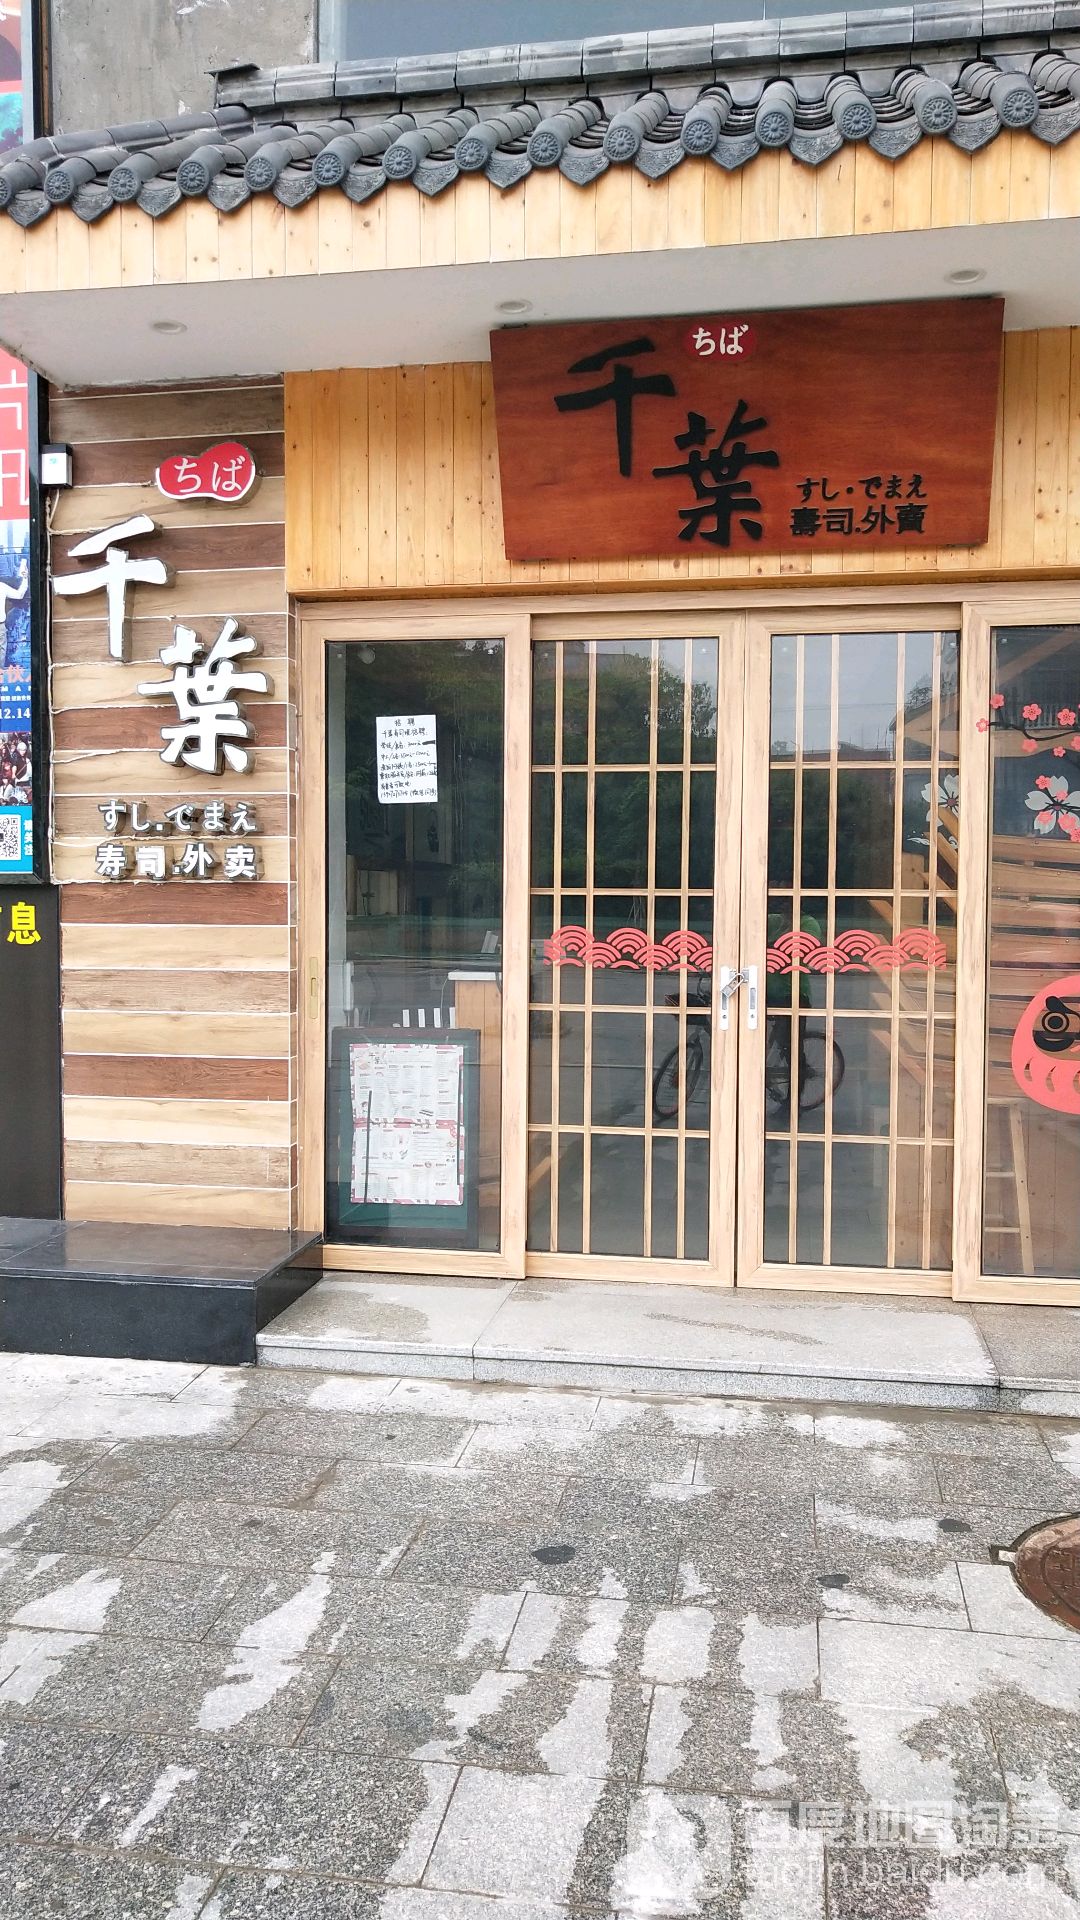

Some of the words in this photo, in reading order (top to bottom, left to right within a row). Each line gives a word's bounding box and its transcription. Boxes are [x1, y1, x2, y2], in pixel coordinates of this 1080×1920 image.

[691, 325, 749, 355] ちば
[173, 457, 246, 494] ちば
[555, 337, 779, 546] 千葉
[52, 514, 270, 774] 千葉
